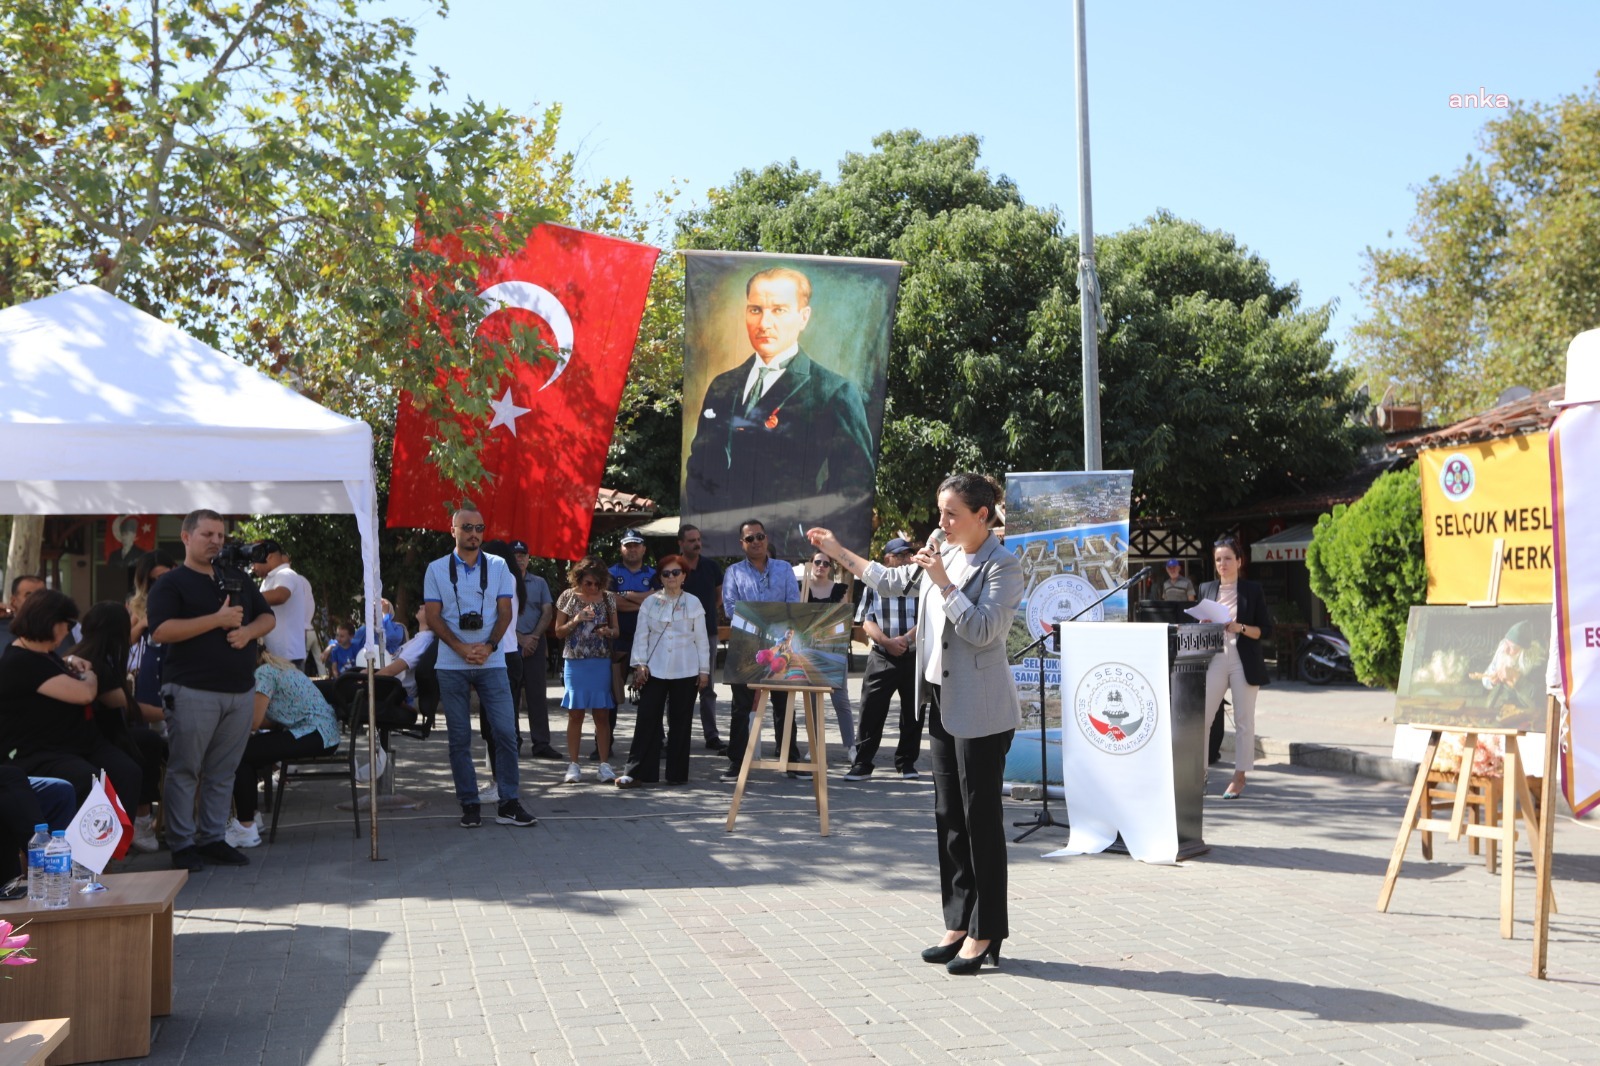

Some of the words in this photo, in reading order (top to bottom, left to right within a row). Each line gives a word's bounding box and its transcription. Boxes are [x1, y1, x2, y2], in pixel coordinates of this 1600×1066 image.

[1435, 511, 1498, 538] SELÇUK
[1504, 506, 1553, 532] MESL
[1502, 545, 1552, 570] MERK
[1014, 671, 1061, 684] SANAKA
[1094, 667, 1134, 681] SESO
[1086, 727, 1105, 745] ESNAF
[1104, 742, 1112, 751] VE
